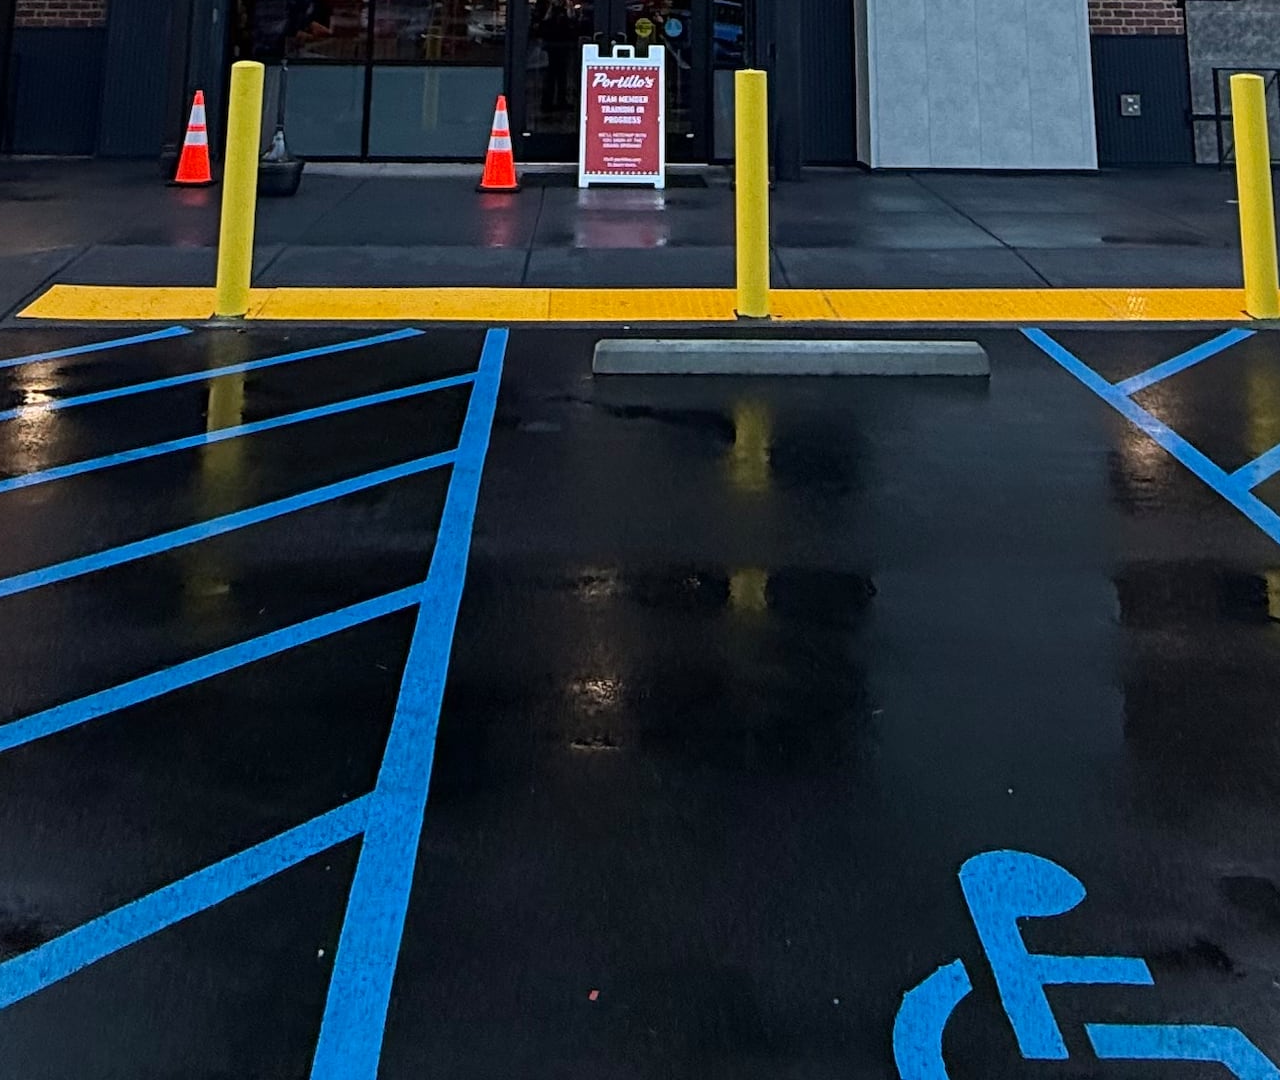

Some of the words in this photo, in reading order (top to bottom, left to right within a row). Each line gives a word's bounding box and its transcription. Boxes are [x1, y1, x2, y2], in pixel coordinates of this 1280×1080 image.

[592, 72, 656, 89] Portillo's
[598, 94, 617, 104] TEAM
[618, 95, 649, 104] MEMBER
[603, 115, 642, 125] PROGRESS
